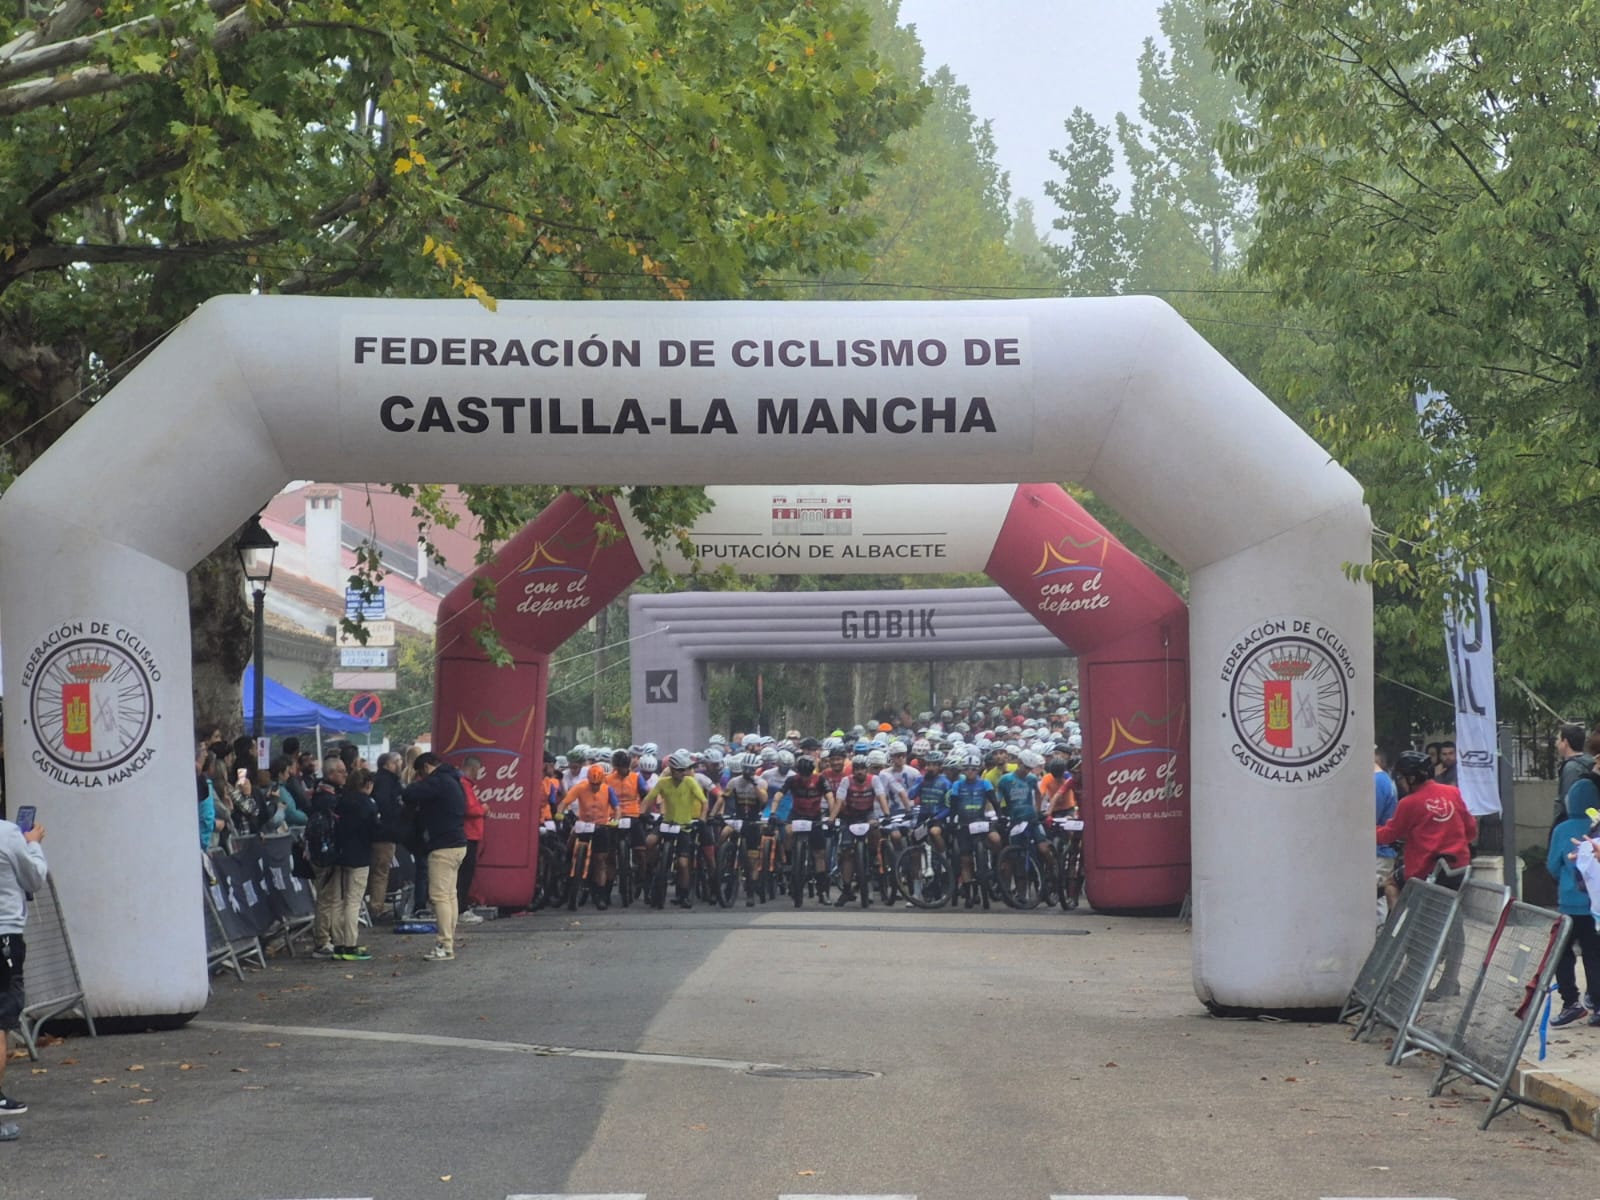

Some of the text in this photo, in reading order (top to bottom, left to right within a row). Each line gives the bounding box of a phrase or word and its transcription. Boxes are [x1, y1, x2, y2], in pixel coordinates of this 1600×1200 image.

[353, 333, 1020, 368] FEDERACIÓN DE CICLISMO DE
[379, 395, 998, 435] CASTILLA-LA MANCHA
[692, 541, 947, 559] IPUTACIÓN DE ALBACETE
[524, 574, 589, 594] con el
[1040, 571, 1102, 596] con el
[516, 595, 591, 616] deporte
[1038, 593, 1110, 616] deporte
[841, 608, 936, 639] GOBIK
[22, 622, 161, 688] FEDERACIÓN DE CICLISMO
[1221, 620, 1355, 682] FEDERACIÓN DE CICLISMO
[32, 747, 156, 788] CASTILLA-LA MANCHA
[496, 757, 520, 779] el
[1231, 743, 1350, 783] CASTILLA-LA MANCHA
[1107, 767, 1147, 785] con
[473, 783, 524, 802] orte
